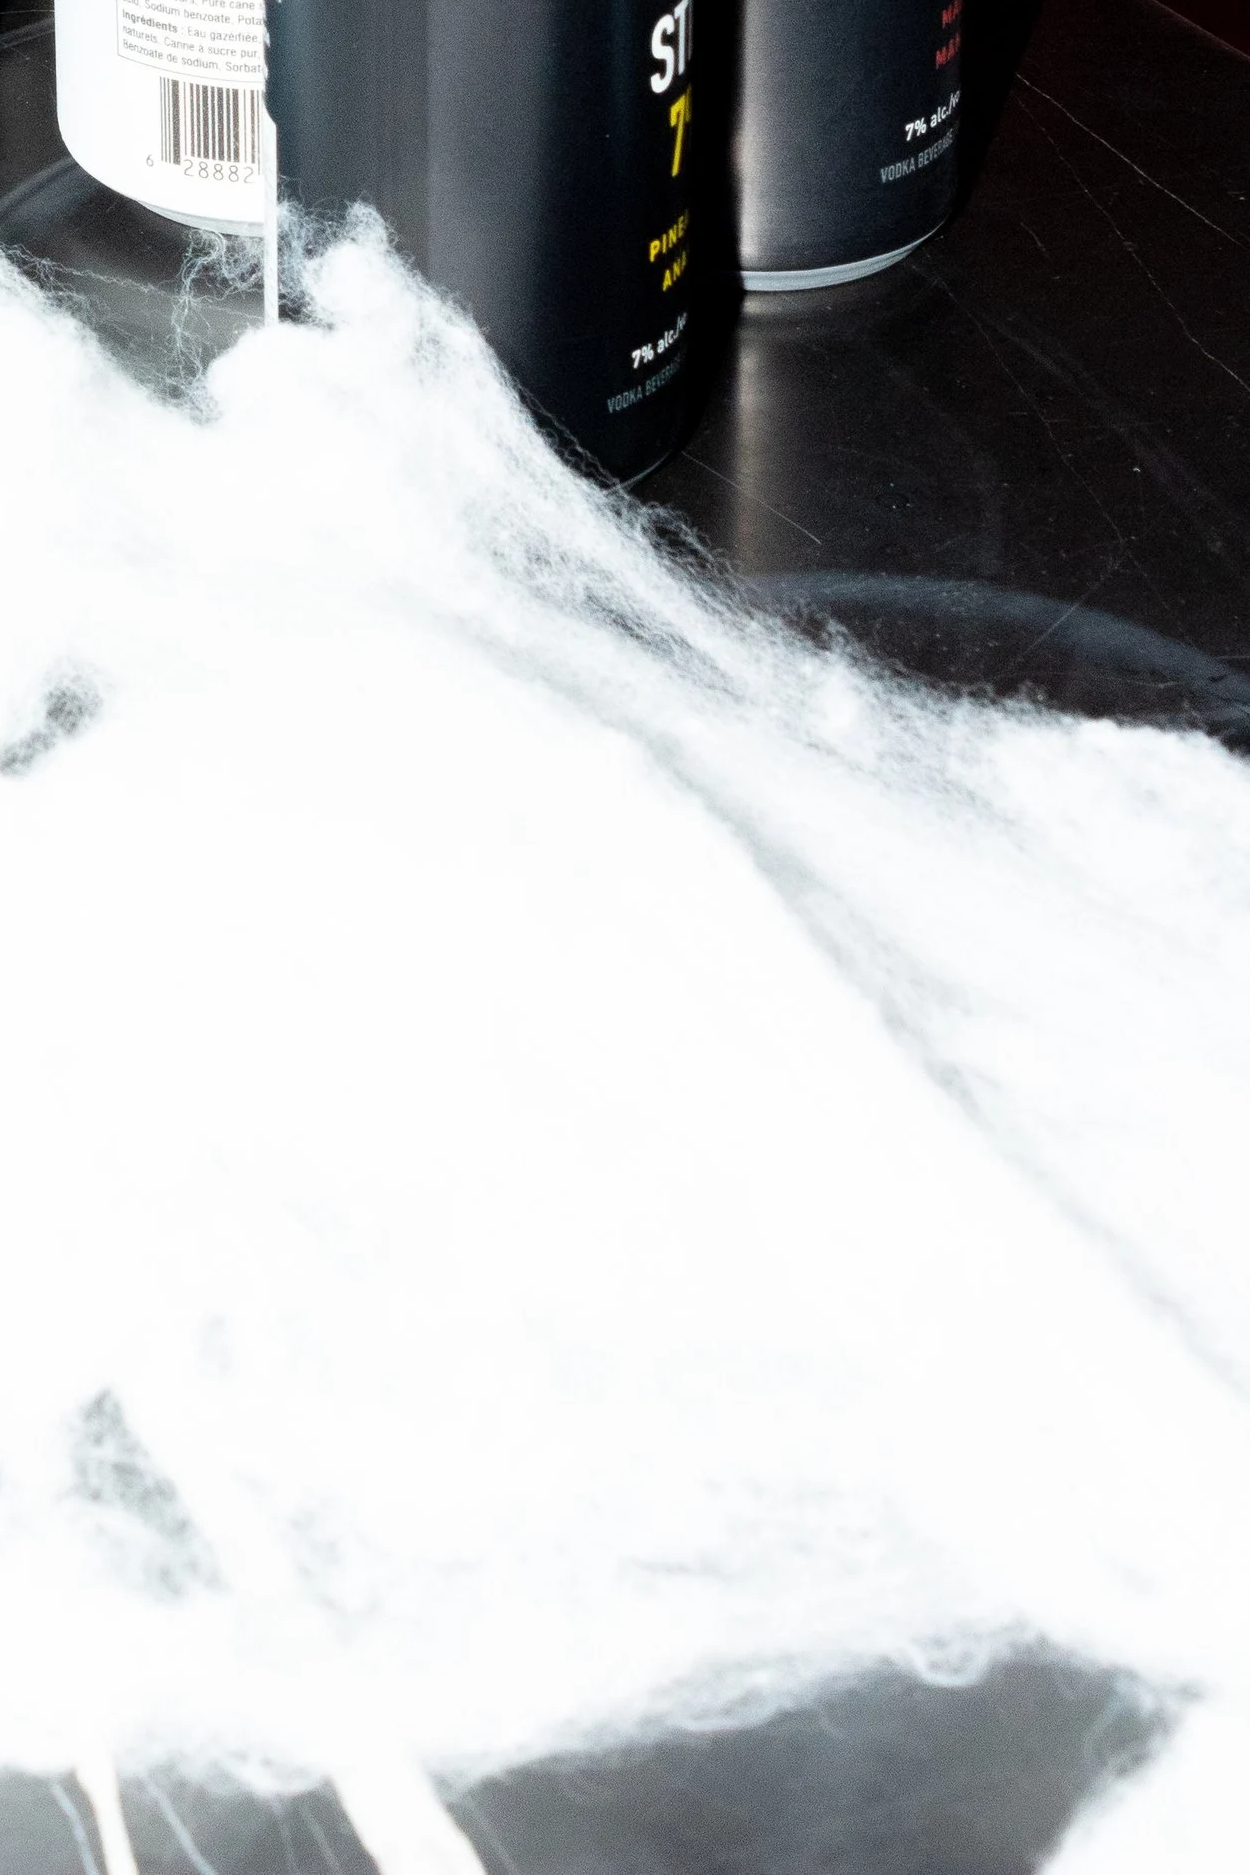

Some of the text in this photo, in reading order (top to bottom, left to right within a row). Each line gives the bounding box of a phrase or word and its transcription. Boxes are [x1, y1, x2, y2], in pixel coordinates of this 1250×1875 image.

[229, 0, 256, 10] cane
[122, 9, 207, 39] Ingrédients Eau
[122, 38, 164, 60] Benzoate
[164, 36, 237, 57] Canne sucre
[905, 116, 928, 142] 7%
[183, 159, 255, 184] 28882
[880, 156, 916, 184] VODKA
[631, 342, 654, 370] 7%
[607, 384, 643, 414] VODKA
